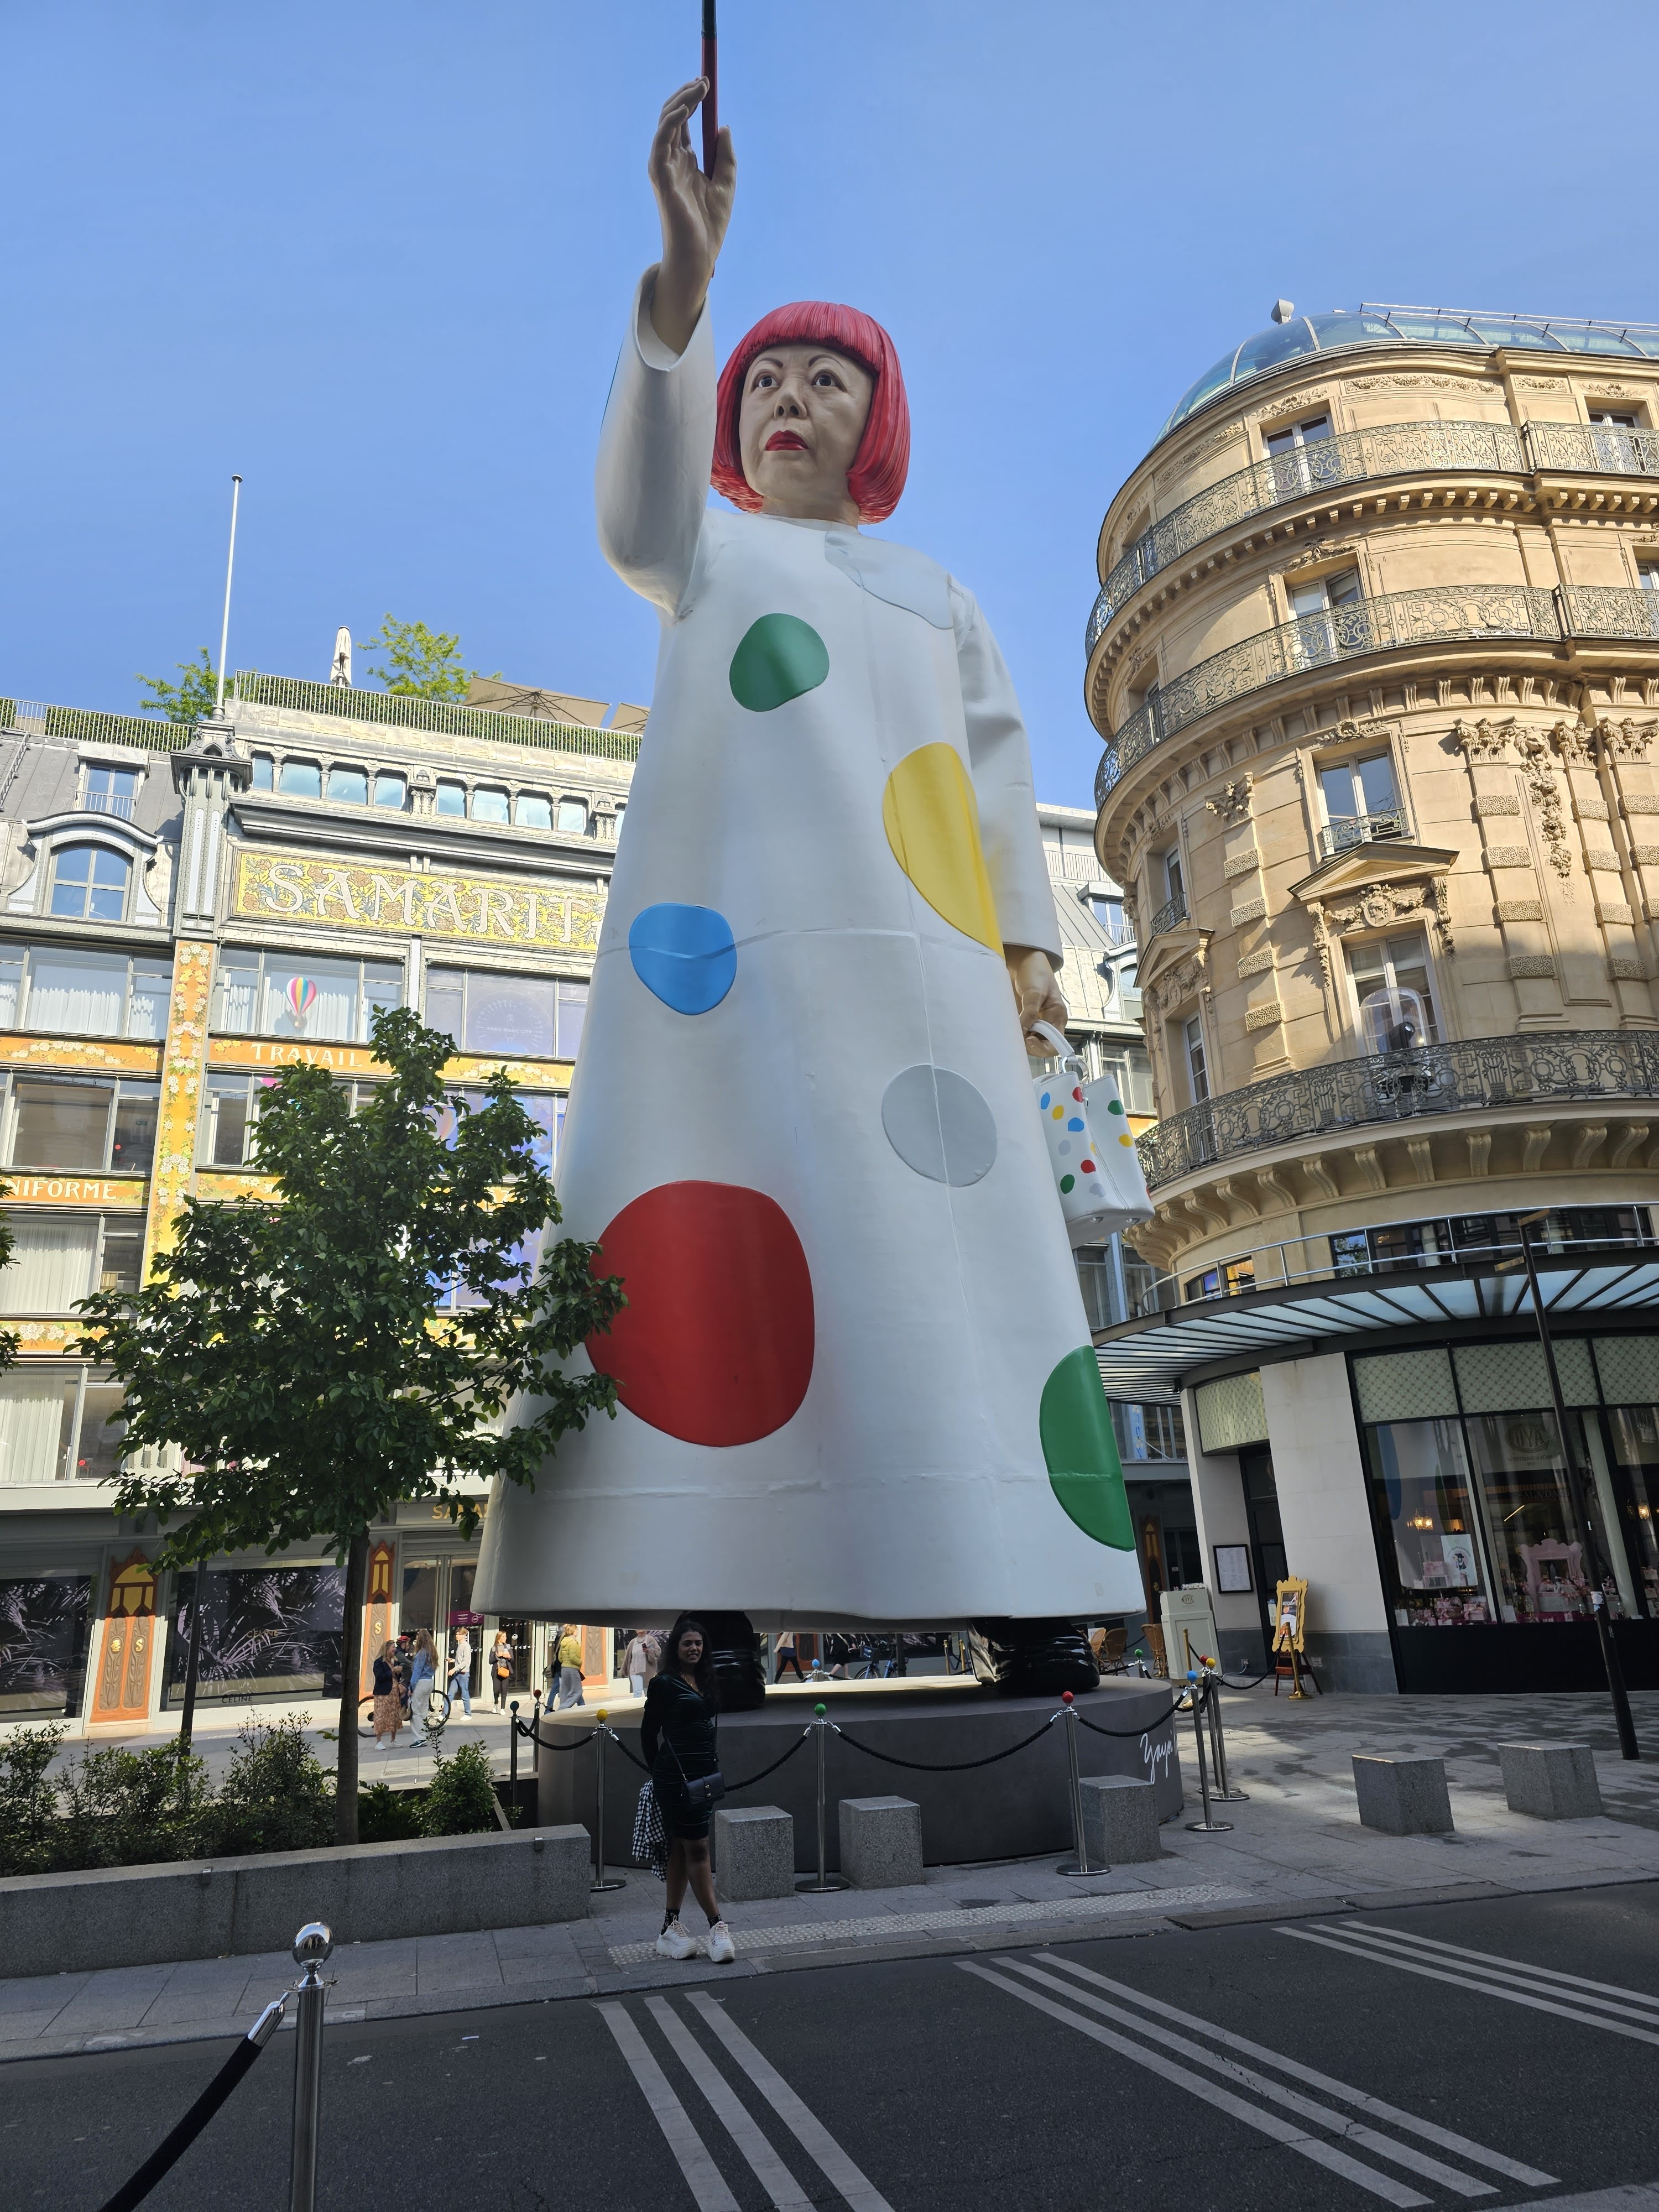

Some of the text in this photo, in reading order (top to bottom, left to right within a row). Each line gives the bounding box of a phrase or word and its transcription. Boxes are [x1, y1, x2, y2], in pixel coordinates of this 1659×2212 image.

[265, 864, 608, 945] SAMARIT
[250, 1043, 363, 1071] TRAVAIL
[247, 1630, 279, 1639] CELINE
[221, 1694, 253, 1704] CELINE
